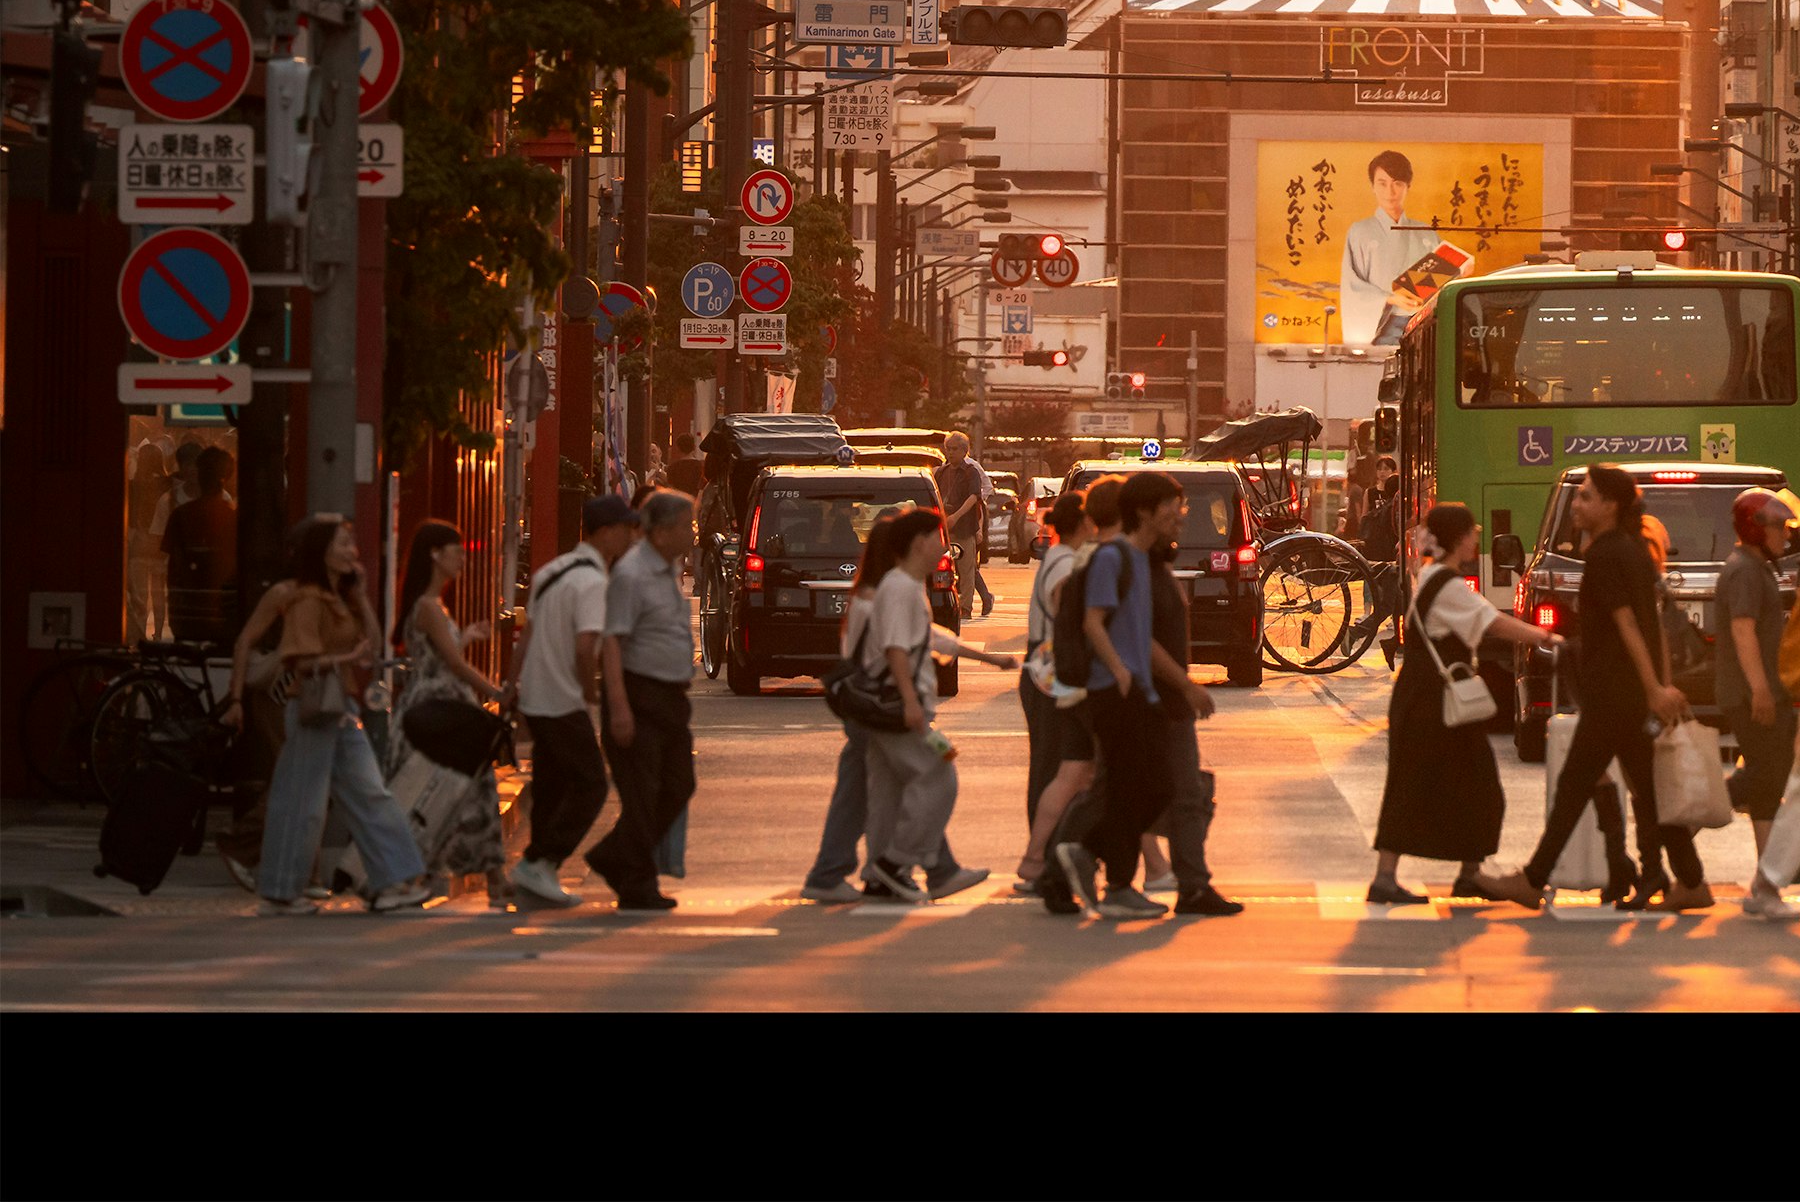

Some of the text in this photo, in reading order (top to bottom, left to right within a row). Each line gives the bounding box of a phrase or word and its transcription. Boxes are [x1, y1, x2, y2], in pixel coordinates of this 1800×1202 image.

[815, 3, 889, 24] 雷門
[805, 25, 896, 39] Kaminarimon Gate
[1329, 27, 1476, 67] FRONT
[1361, 82, 1443, 101] asakusa
[128, 134, 246, 157] 人の乗降を除く
[1501, 153, 1524, 227] にっぽんに
[1312, 158, 1336, 245] かねふくの
[1450, 180, 1466, 227] あり
[1474, 165, 1492, 252] うまいもの
[1286, 175, 1306, 266] めんたいこ
[1045, 259, 1070, 277] 40
[693, 277, 714, 311] P
[742, 318, 784, 329] 人の乗降を除
[1281, 316, 1321, 327] かねふく
[742, 330, 784, 341] 日曜・休日を除
[1469, 326, 1506, 338] G741
[1564, 436, 1689, 454] ノンステップバス
[773, 490, 800, 498] 5785
